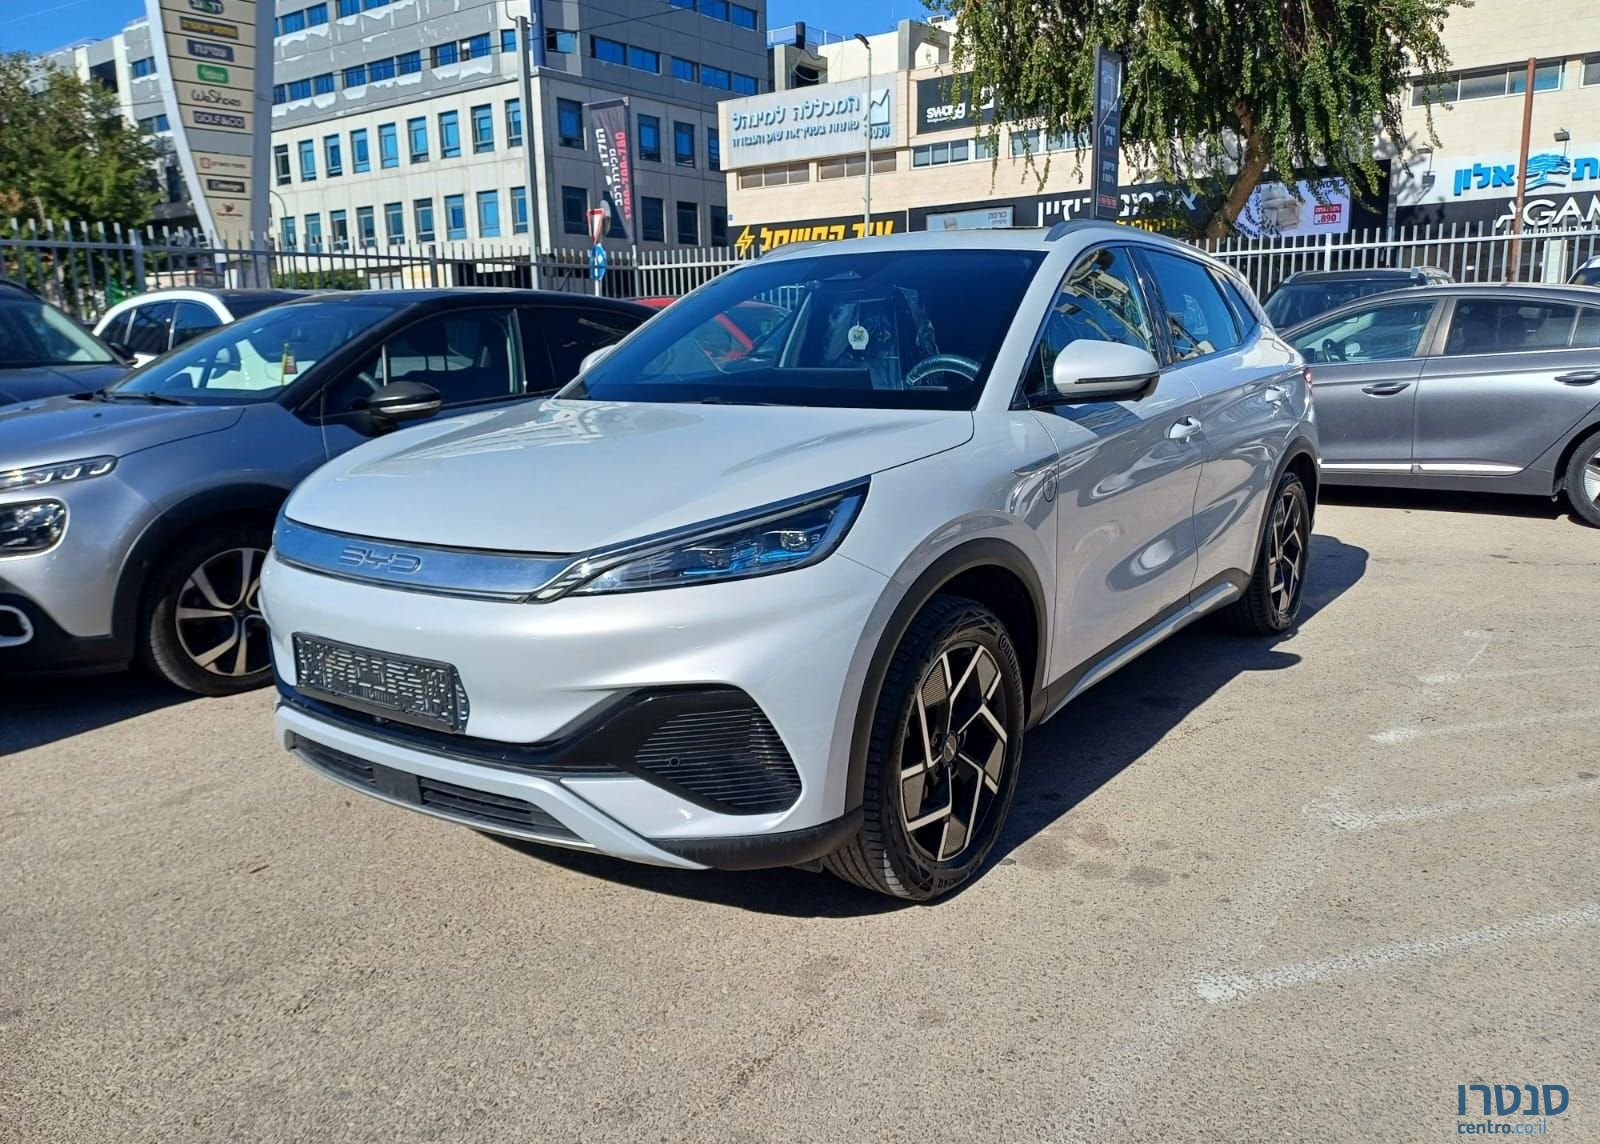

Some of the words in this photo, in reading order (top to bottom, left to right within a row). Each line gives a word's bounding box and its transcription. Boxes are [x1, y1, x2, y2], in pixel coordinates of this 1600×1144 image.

[732, 105, 786, 131] למינהל
[793, 96, 860, 122] המכללה
[609, 148, 621, 182] מכירת
[1453, 163, 1515, 197] אלון
[613, 185, 624, 206] רכב
[760, 225, 846, 251] החשמל
[338, 545, 423, 575] BYD
